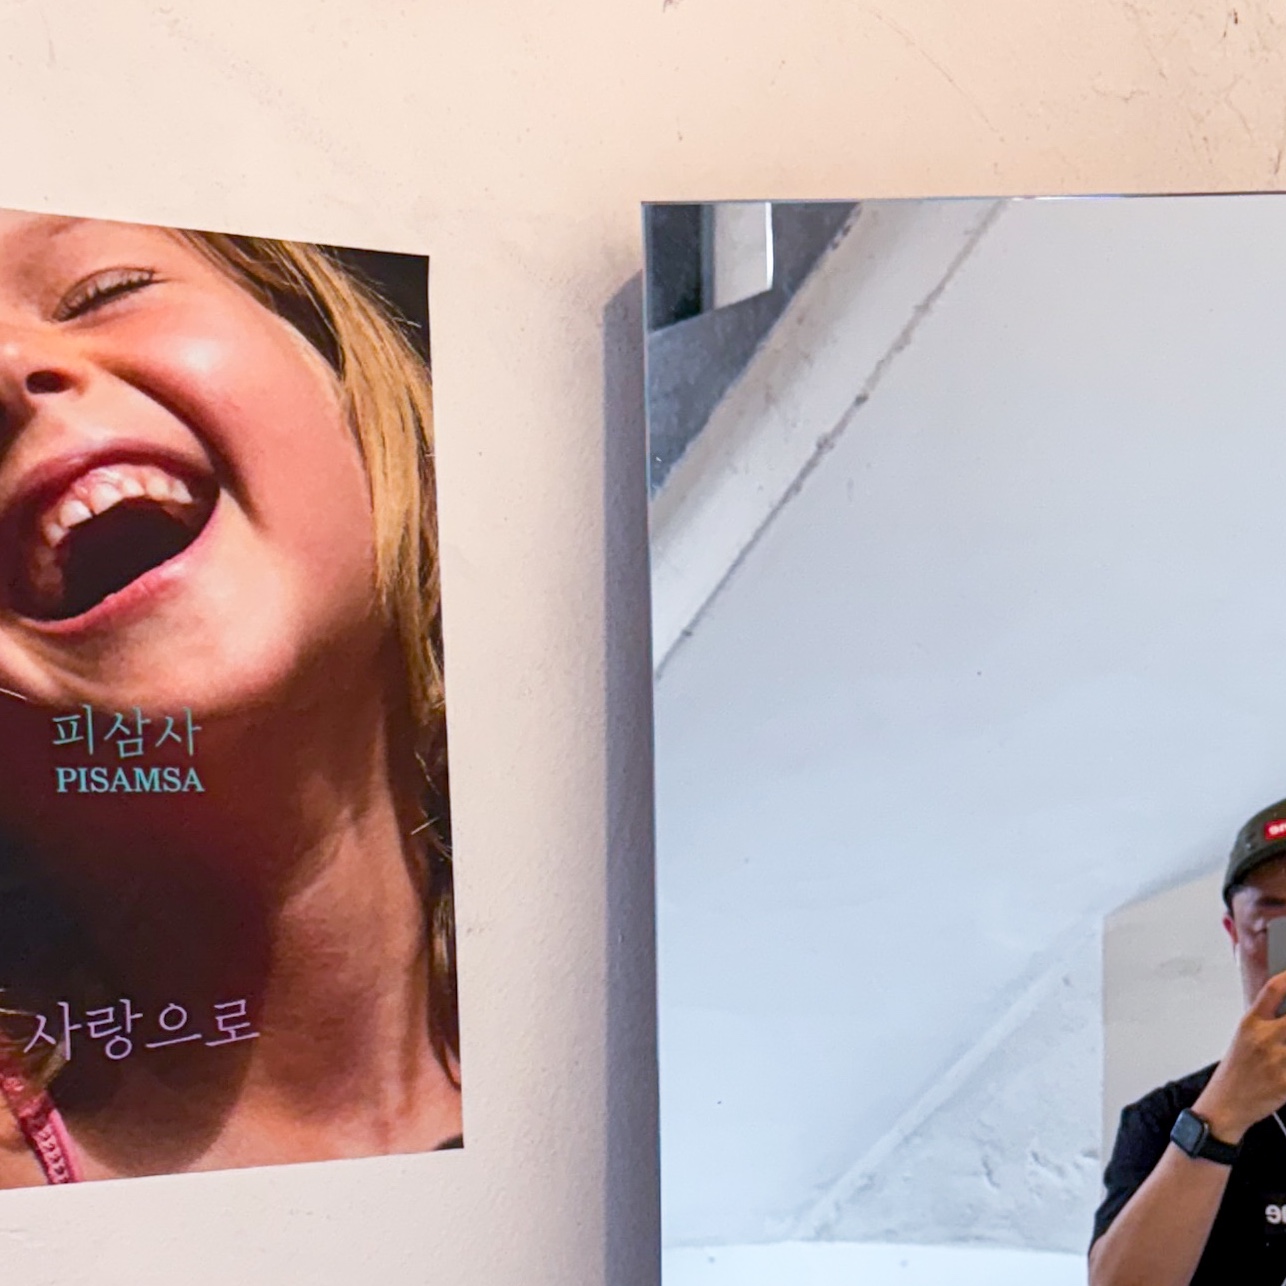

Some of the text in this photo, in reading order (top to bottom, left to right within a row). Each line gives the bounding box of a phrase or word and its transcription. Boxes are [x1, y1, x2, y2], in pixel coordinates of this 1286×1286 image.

[52, 704, 203, 758] 피삼사
[55, 767, 206, 793] PISAMSA
[23, 999, 261, 1061] 사랑으로
